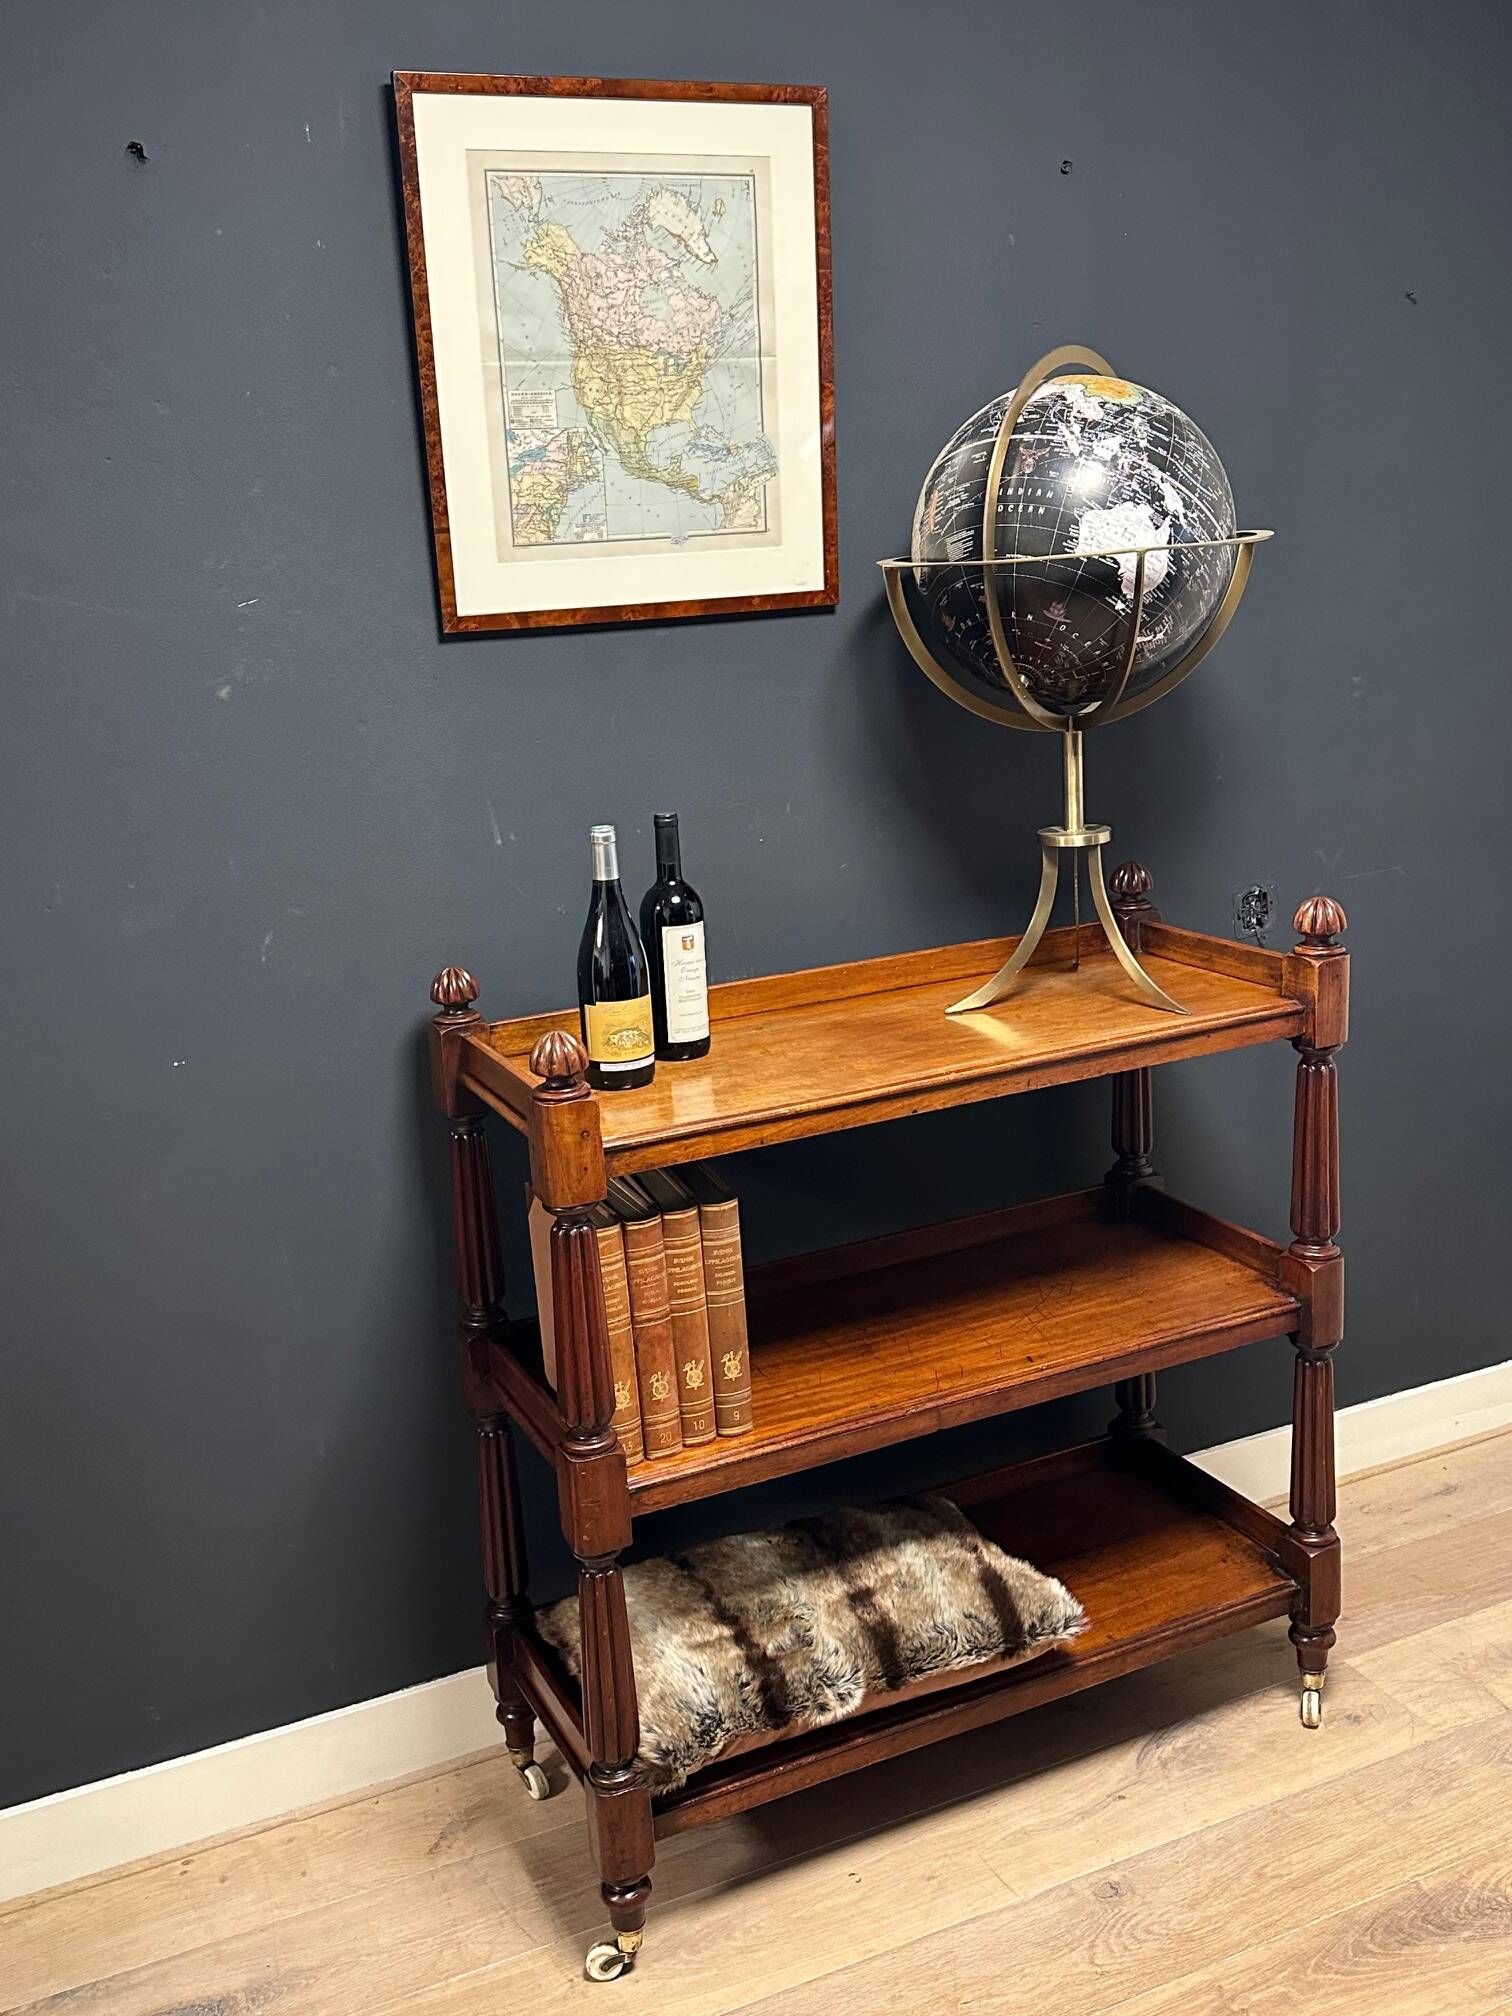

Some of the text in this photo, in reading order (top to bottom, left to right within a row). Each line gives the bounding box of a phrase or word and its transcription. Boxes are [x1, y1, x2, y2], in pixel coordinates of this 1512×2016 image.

[999, 487, 1054, 499] INDIAN
[997, 503, 1046, 515] OCEAN
[733, 1410, 740, 1421] 9
[693, 1419, 705, 1430] 10
[660, 1431, 672, 1443] 20
